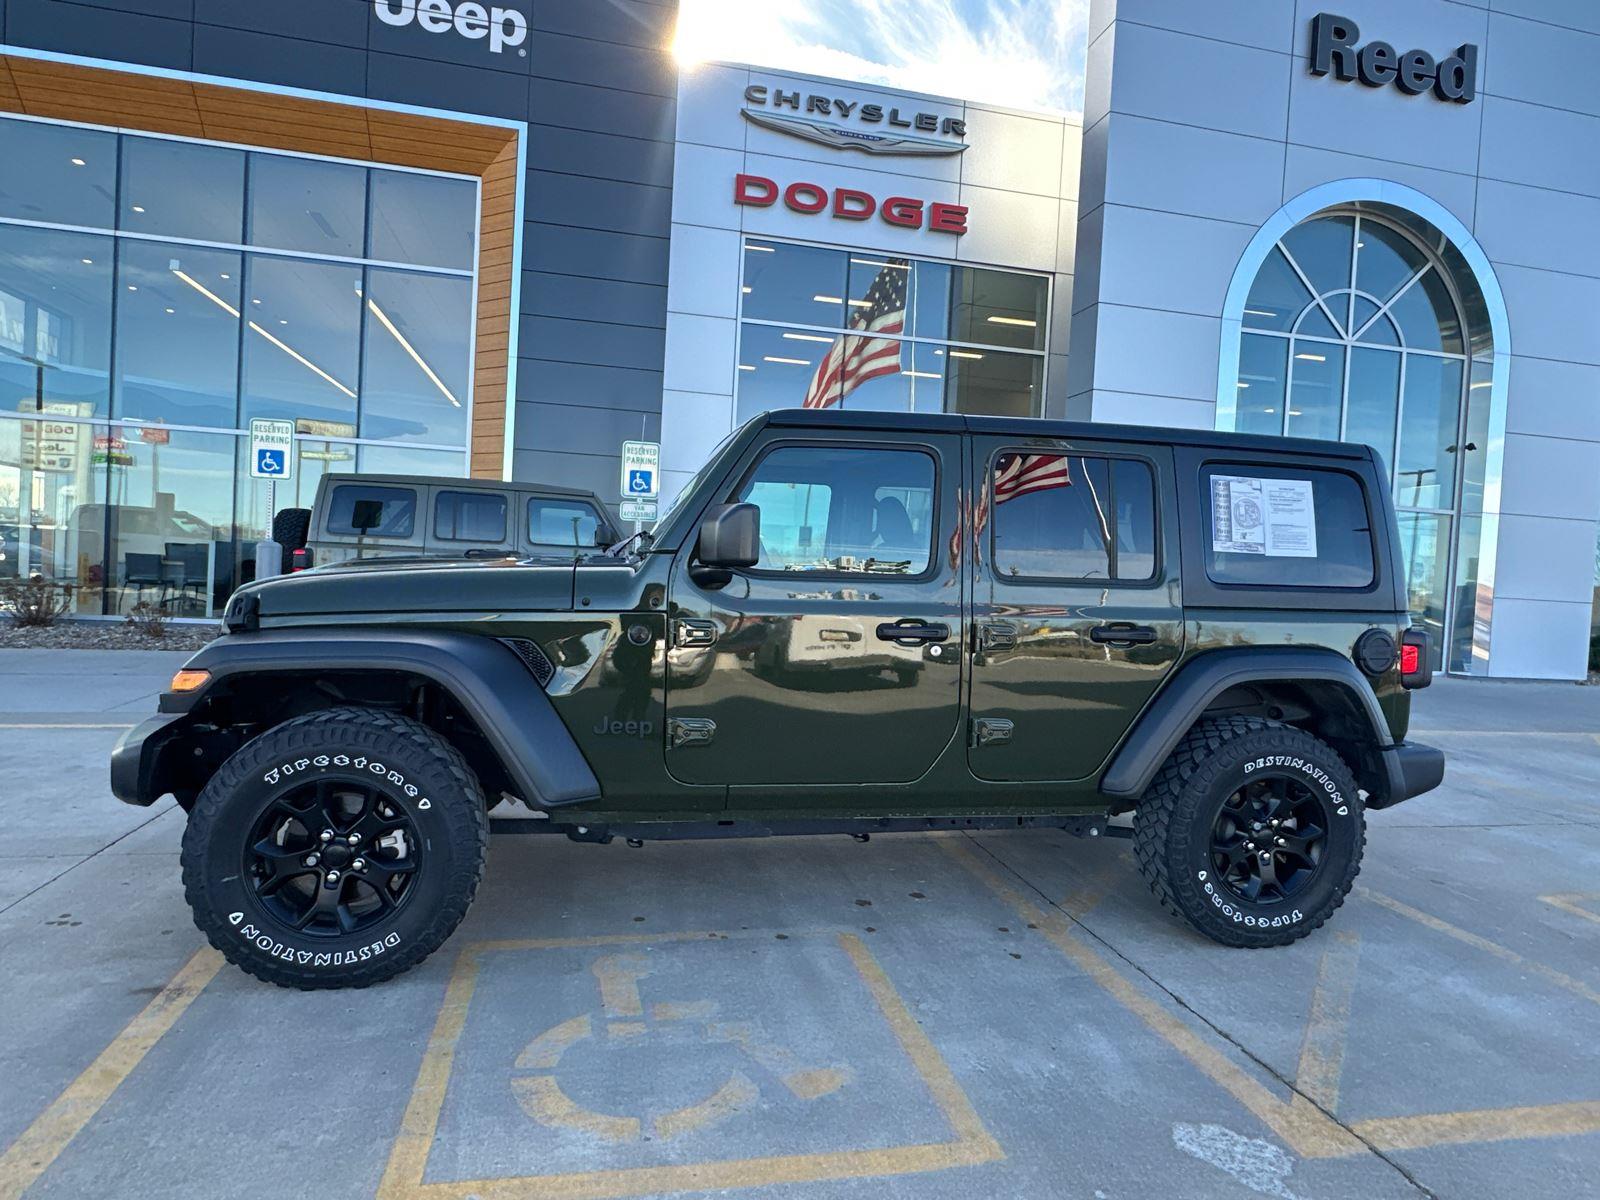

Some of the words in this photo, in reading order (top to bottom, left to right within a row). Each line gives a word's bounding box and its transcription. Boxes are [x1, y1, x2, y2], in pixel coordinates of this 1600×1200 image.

[374, 0, 528, 53] Jeep
[1310, 12, 1478, 104] Reed
[744, 85, 967, 136] CHRYSLER
[734, 173, 969, 235] DODGE
[254, 423, 290, 434] RESERVED
[254, 434, 290, 445] PARKING
[626, 446, 657, 456] RESERVED
[626, 456, 657, 465] PARKING
[593, 716, 653, 738] Jeep
[264, 755, 418, 797] Firestone
[1244, 756, 1343, 804] DESTINATION
[1204, 883, 1303, 927] Firestone
[241, 924, 400, 966] DESTINATION
